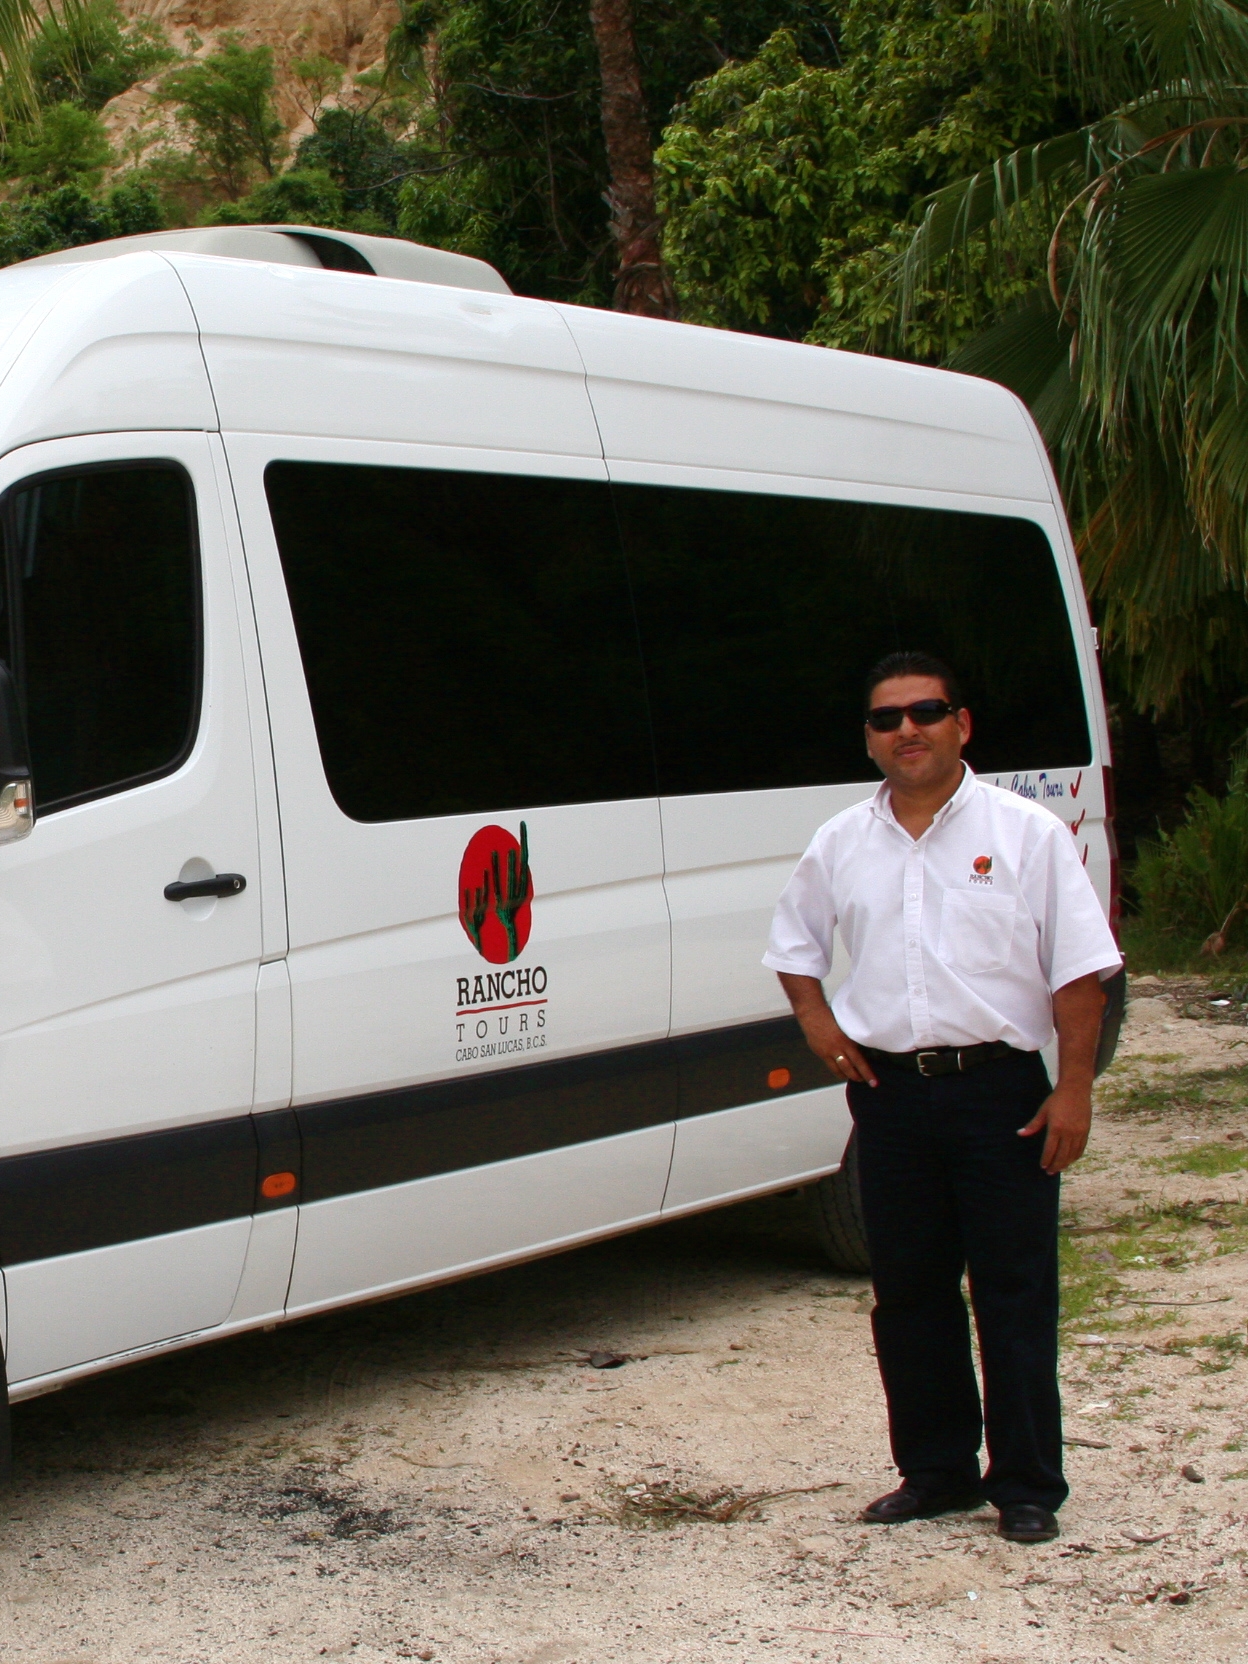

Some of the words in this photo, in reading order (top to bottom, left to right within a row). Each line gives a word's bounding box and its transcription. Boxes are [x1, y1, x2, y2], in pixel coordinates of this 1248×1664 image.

[1039, 772, 1063, 799] Tours
[456, 965, 548, 1006] RANCHO
[455, 1009, 546, 1042] TOURS
[455, 1046, 479, 1062] CABO
[480, 1043, 496, 1058] SAN
[497, 1038, 525, 1055] LUCAS,
[526, 1034, 548, 1049] B.C.S.
